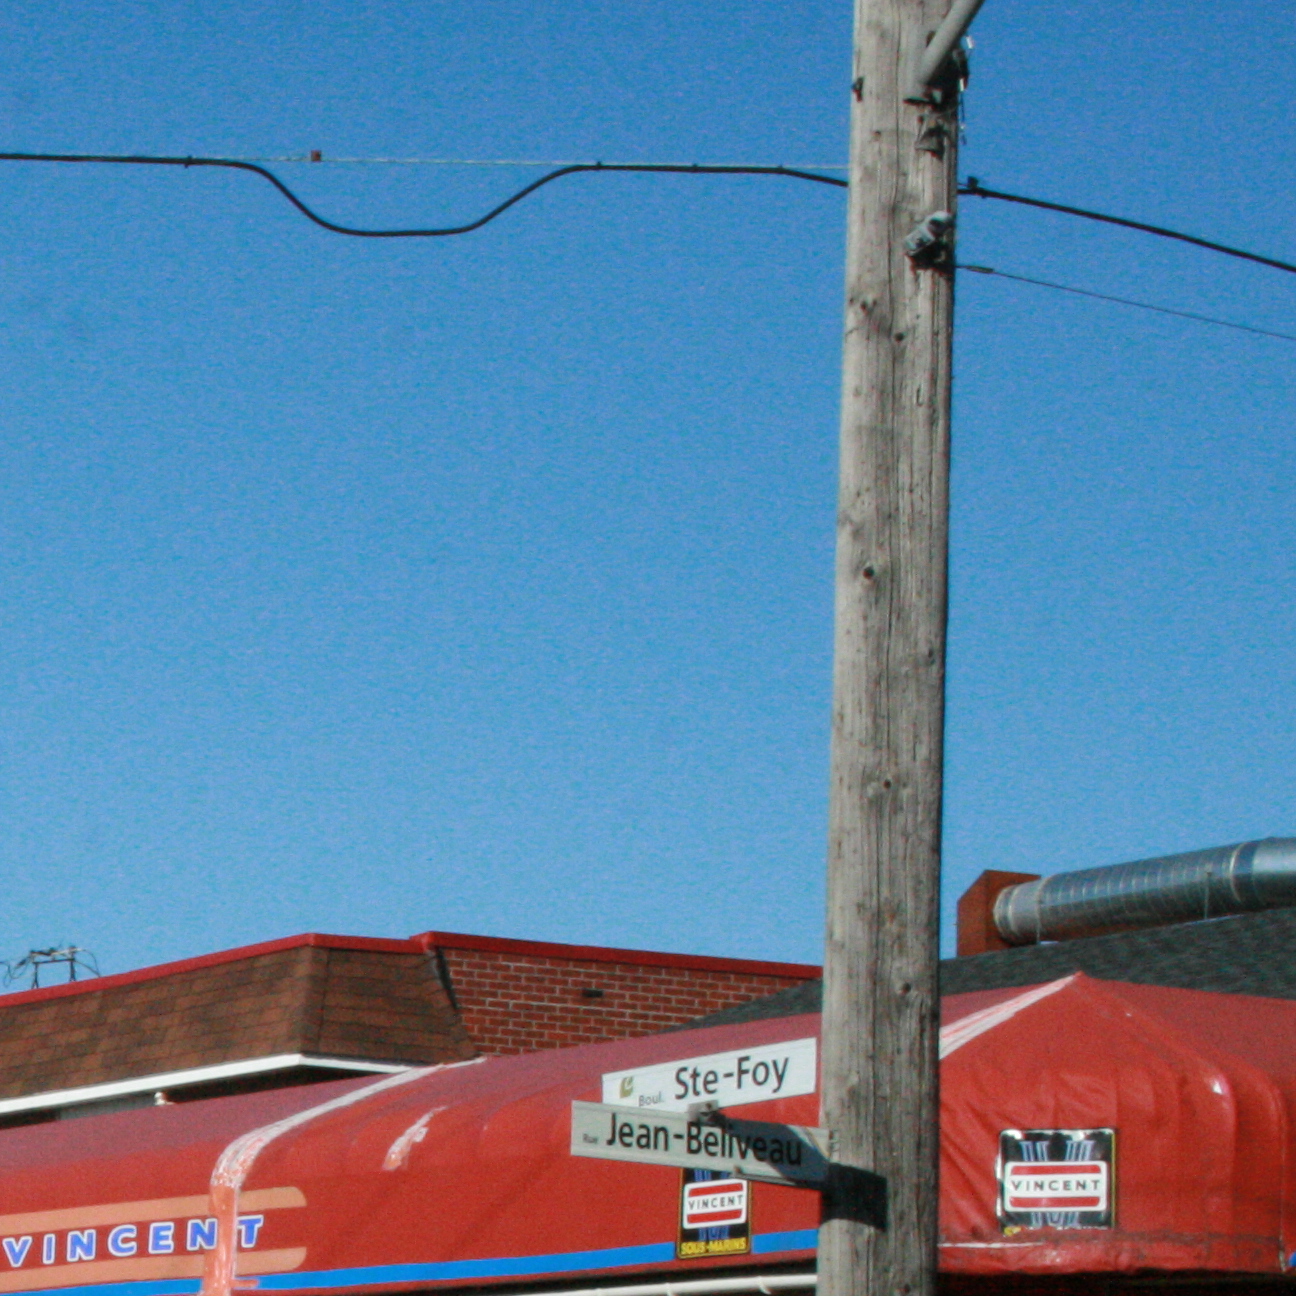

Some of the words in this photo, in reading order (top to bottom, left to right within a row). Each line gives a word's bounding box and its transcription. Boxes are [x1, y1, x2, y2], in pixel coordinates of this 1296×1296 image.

[675, 1056, 790, 1100] Ste-Foy
[1010, 1180, 1101, 1191] VINCENT
[688, 1195, 743, 1210] VINCENT
[2, 1215, 264, 1268] VINCENT
